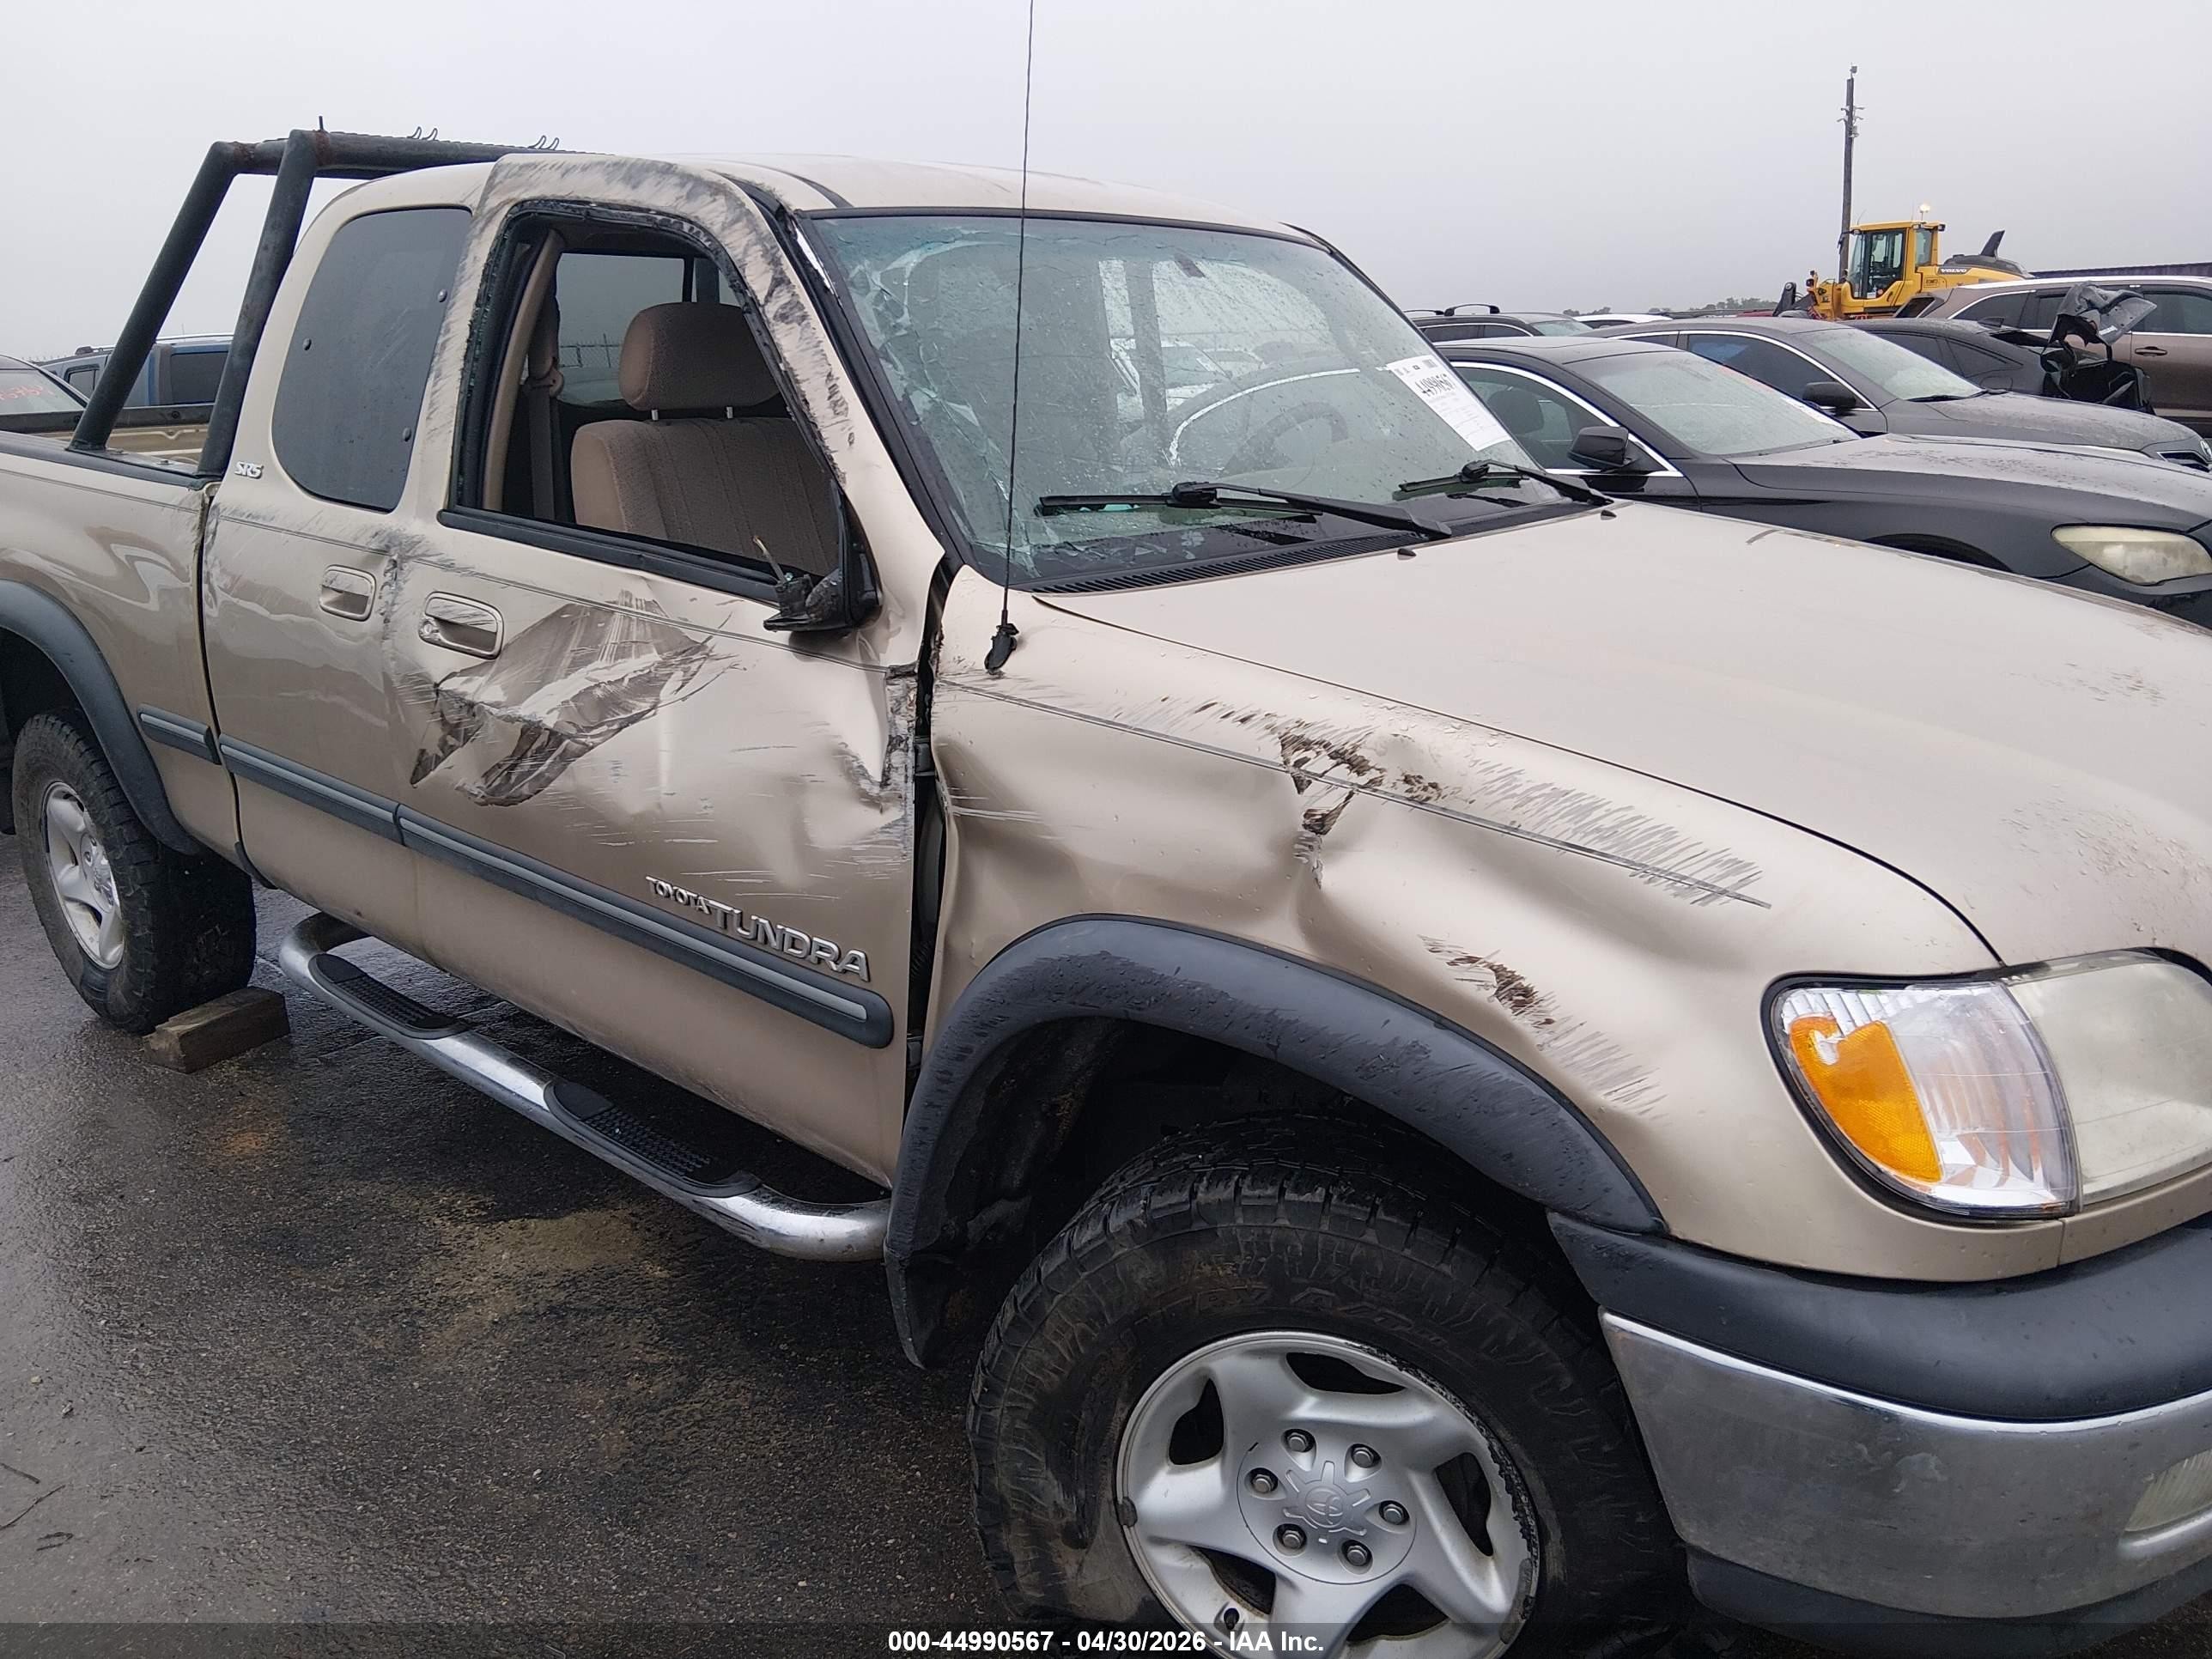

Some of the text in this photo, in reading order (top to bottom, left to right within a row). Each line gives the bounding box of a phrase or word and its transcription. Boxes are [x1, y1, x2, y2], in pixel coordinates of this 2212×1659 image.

[234, 460, 263, 479] SR5
[646, 876, 871, 982] TOYOTA TUNDRA
